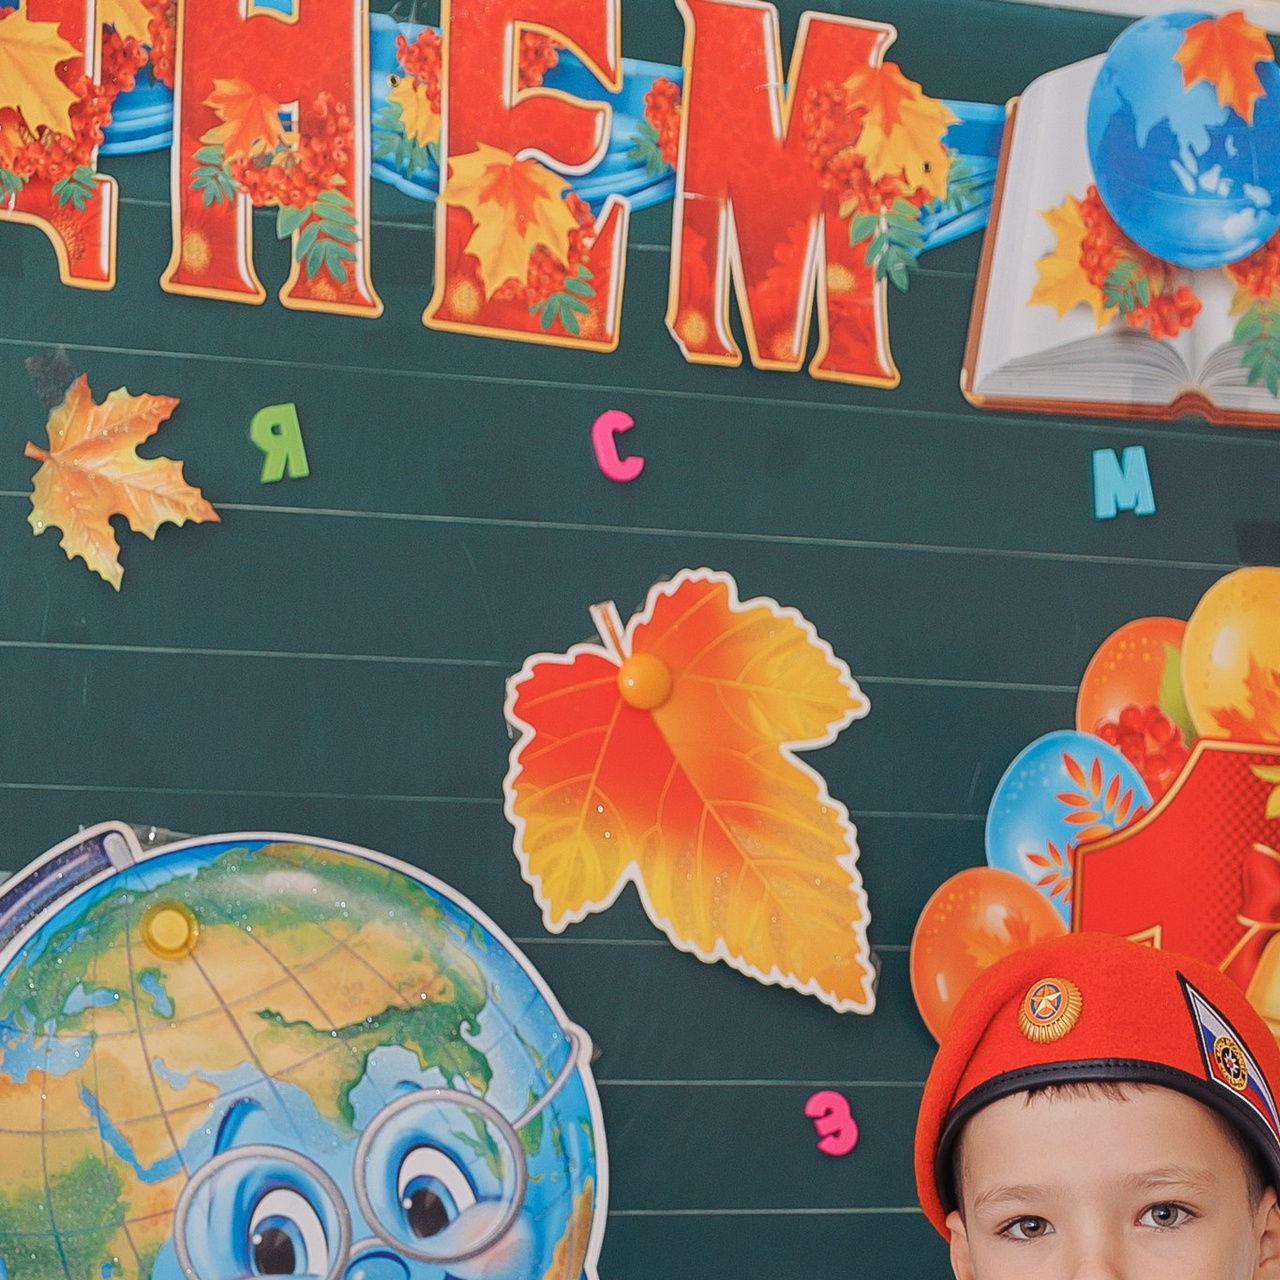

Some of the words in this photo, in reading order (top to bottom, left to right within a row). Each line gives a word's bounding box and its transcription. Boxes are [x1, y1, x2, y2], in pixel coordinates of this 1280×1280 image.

[250, 402, 310, 483] Я
[591, 409, 645, 483] С
[1091, 444, 1157, 521] М
